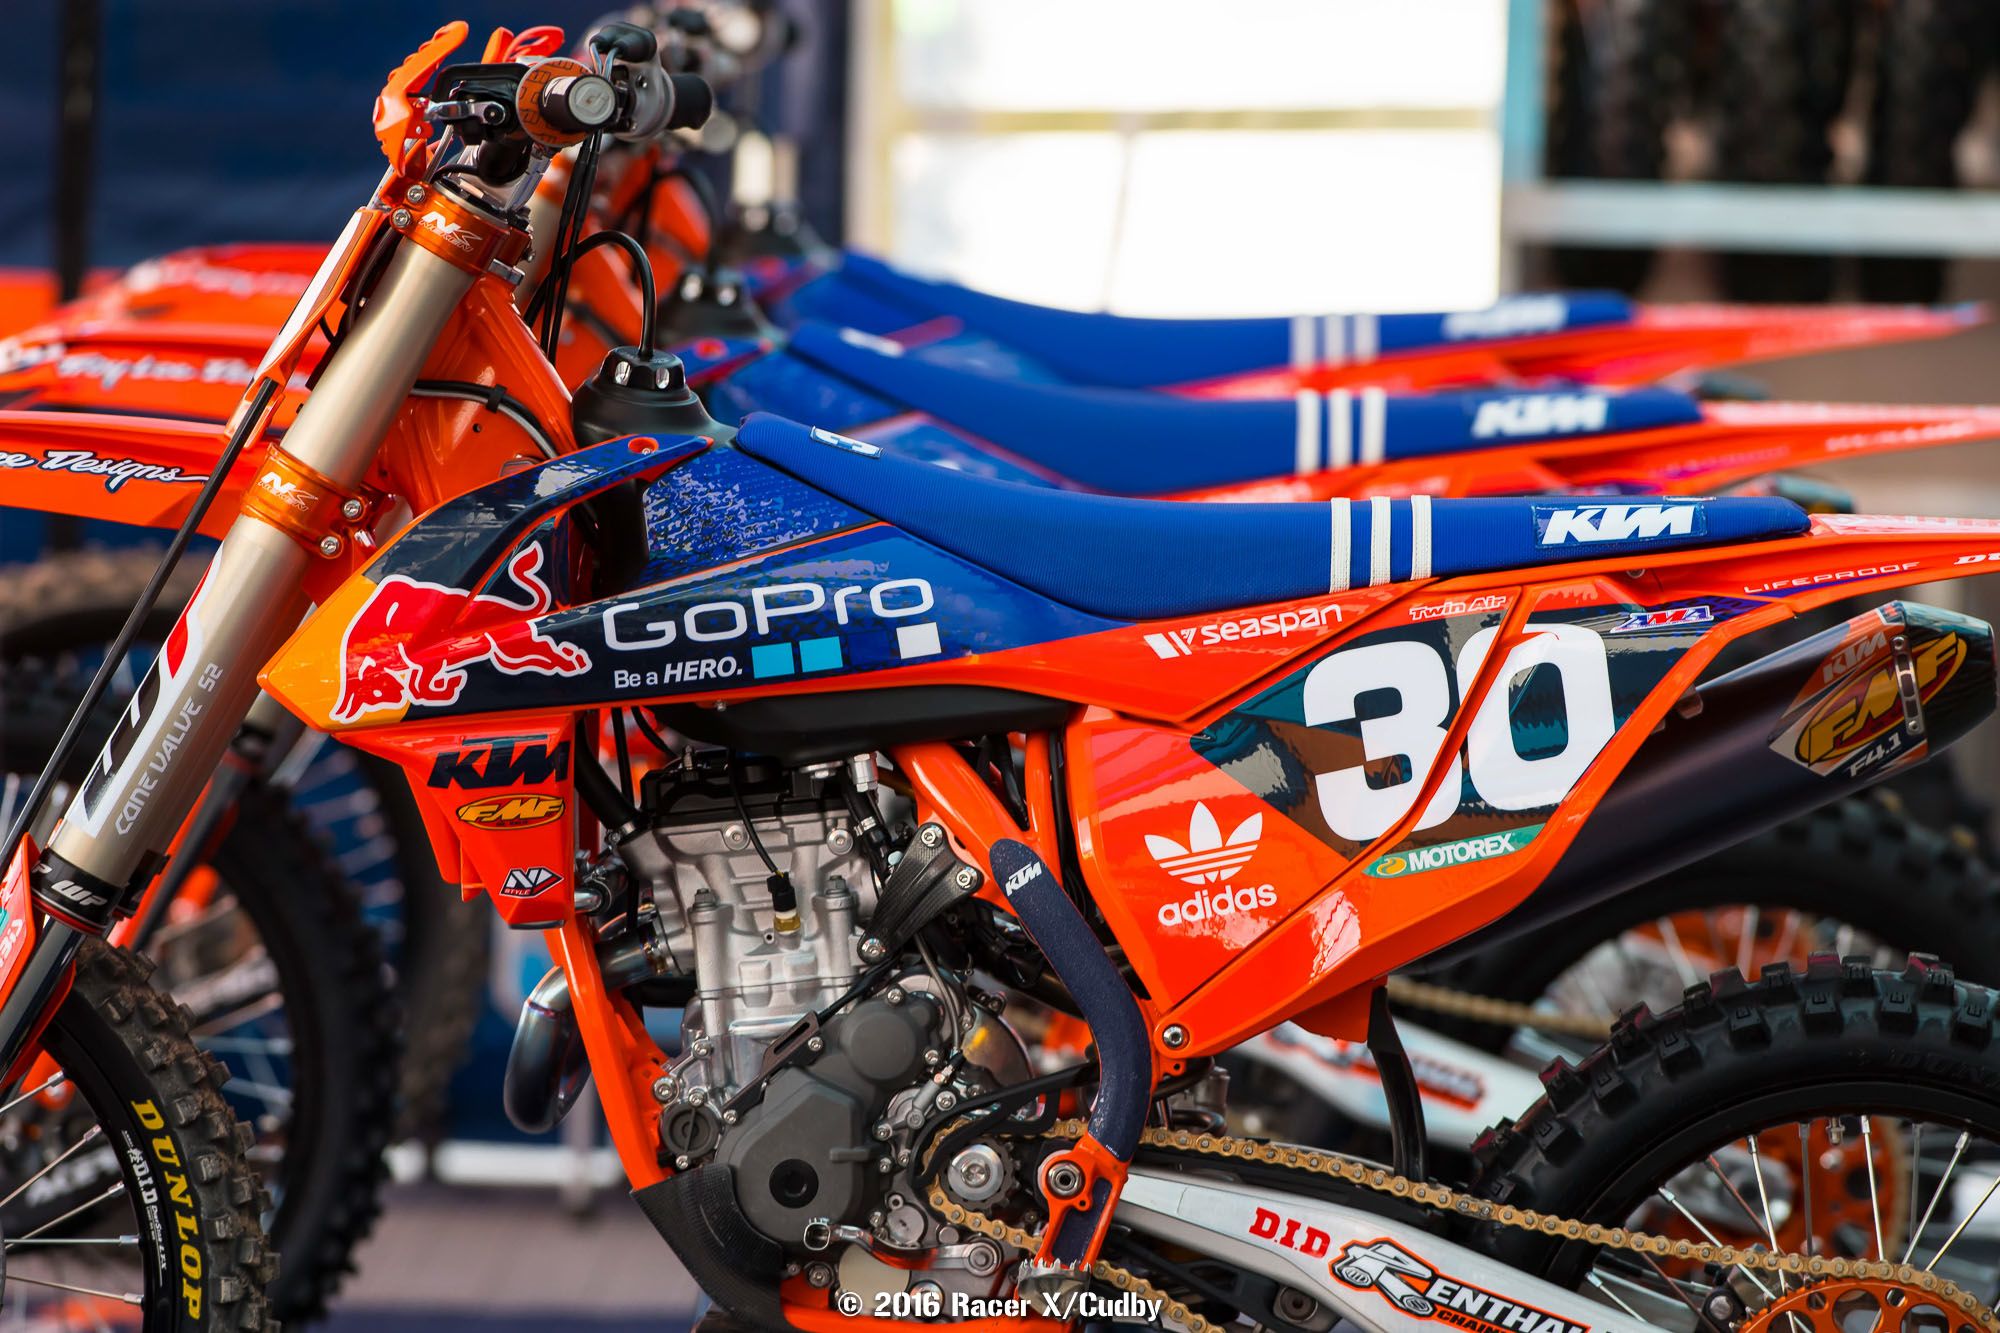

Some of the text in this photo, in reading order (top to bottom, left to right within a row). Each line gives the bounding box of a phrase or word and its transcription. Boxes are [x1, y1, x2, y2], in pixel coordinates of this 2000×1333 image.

[41, 450, 209, 491] Designs
[1541, 504, 1696, 545] KTM
[1743, 562, 1920, 594] LIFEPROOF
[602, 578, 935, 651] GoPro
[1202, 604, 1342, 646] seaspan
[1409, 596, 1507, 621] Twin Air
[1613, 605, 1713, 632] AMA
[614, 656, 743, 689] Be a HERO.
[1823, 631, 1888, 684] KTM
[1809, 631, 1957, 764] FMF
[149, 696, 203, 775] VALVE
[1303, 623, 1616, 841] 30
[427, 734, 571, 790] KTM
[1850, 732, 1902, 777] F4.1
[459, 798, 564, 823] FMF
[1409, 833, 1516, 872] MOTOREX
[51, 879, 108, 906] WP
[1005, 861, 1042, 897] KTM
[1158, 884, 1278, 927] adidas
[131, 1098, 203, 1320] DUNLOP
[1249, 1207, 1331, 1259] D.I.D
